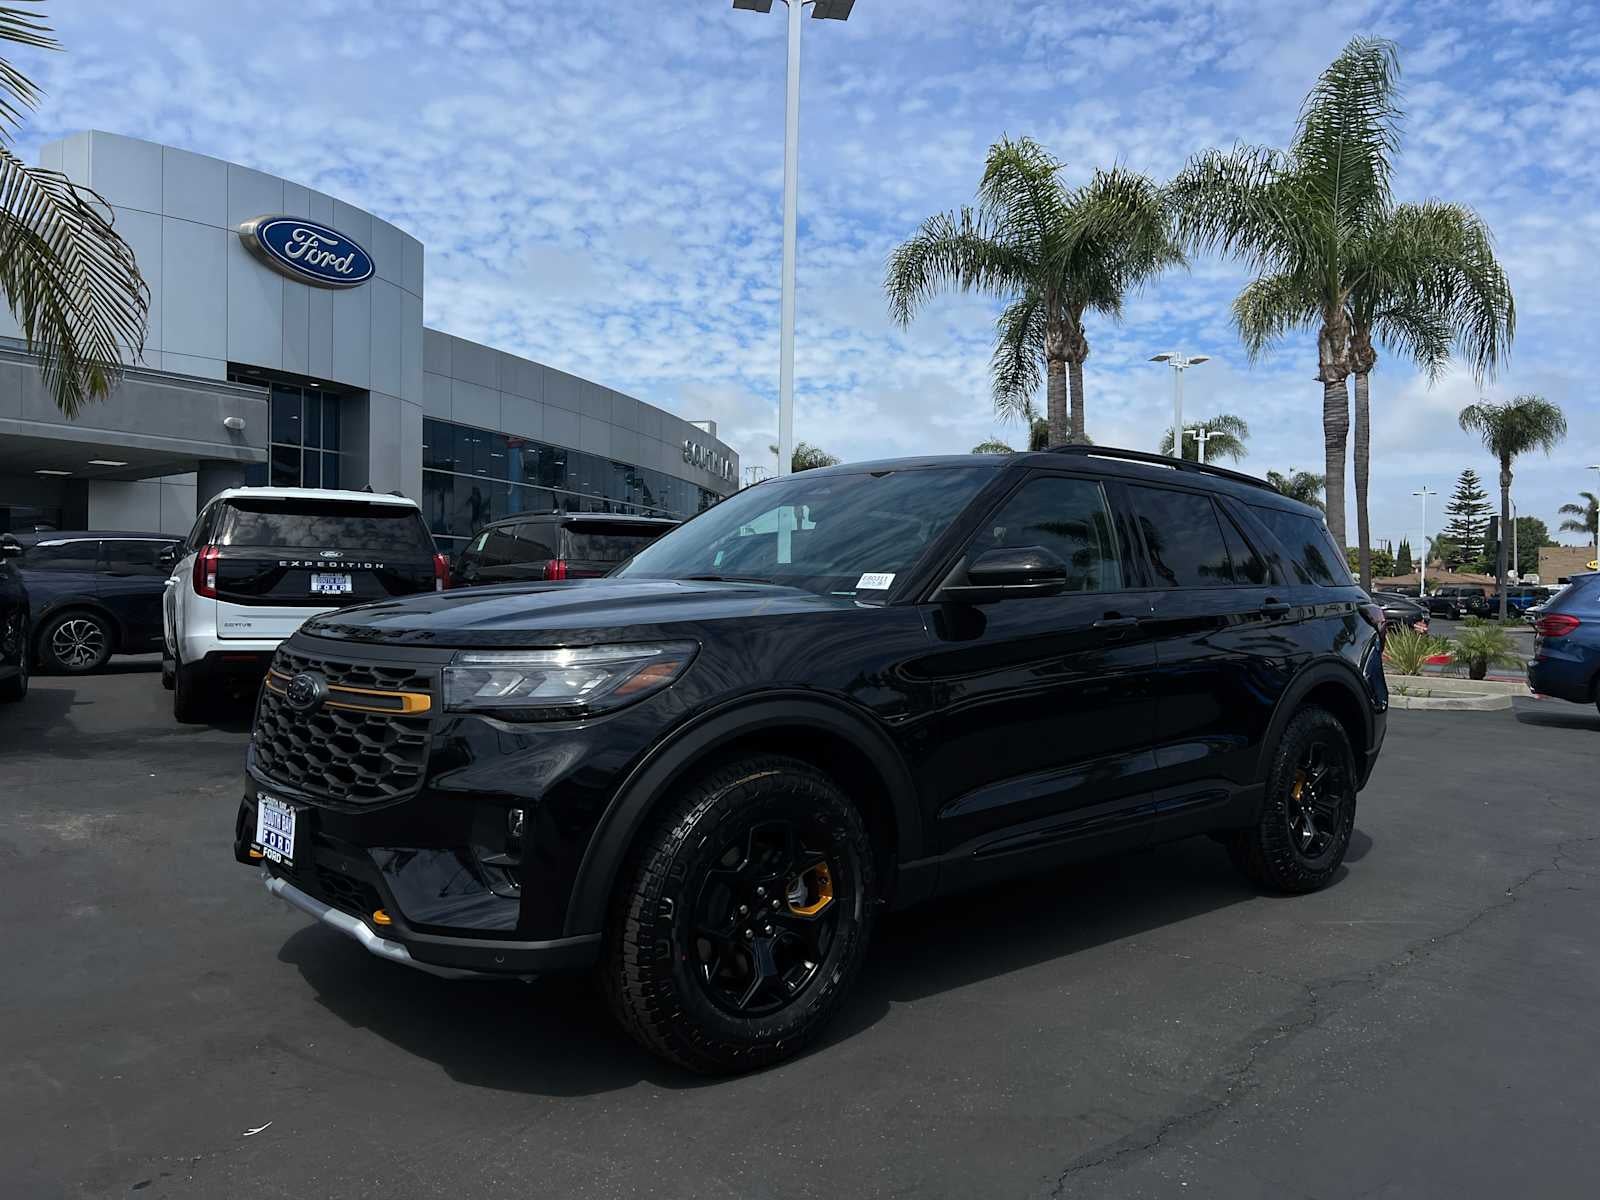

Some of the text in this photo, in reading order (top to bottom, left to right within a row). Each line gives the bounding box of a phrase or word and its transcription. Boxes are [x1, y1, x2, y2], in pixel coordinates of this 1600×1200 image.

[284, 228, 355, 274] Ford
[279, 561, 384, 569] EXPEDITION
[263, 807, 281, 829] SOUTH
[263, 829, 291, 854] FORD
[263, 847, 282, 863] FORD
